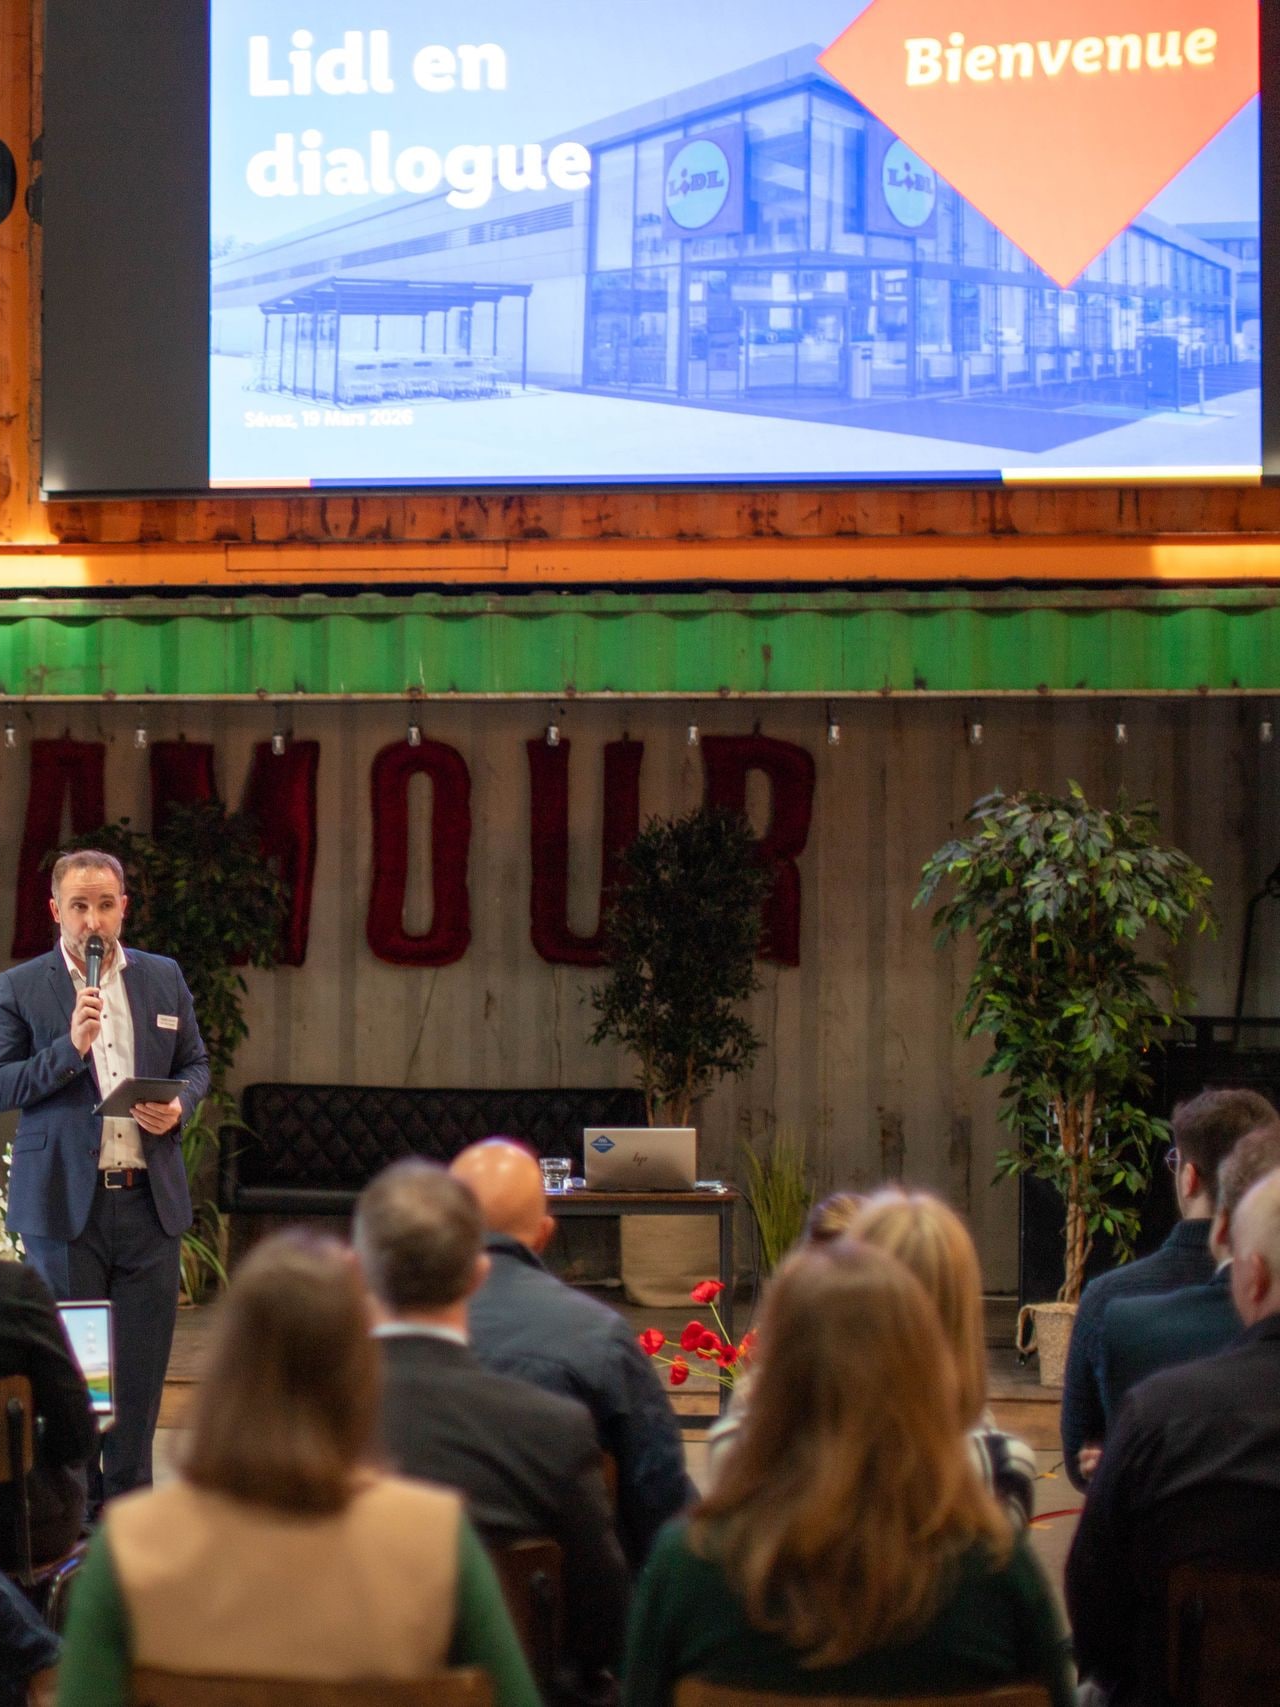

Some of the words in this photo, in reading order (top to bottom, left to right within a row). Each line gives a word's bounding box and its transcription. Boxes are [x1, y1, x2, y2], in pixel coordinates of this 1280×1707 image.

[248, 28, 394, 97] Lidl
[412, 41, 508, 92] en
[903, 27, 1218, 88] Bienvenue
[245, 128, 593, 210] dialogue
